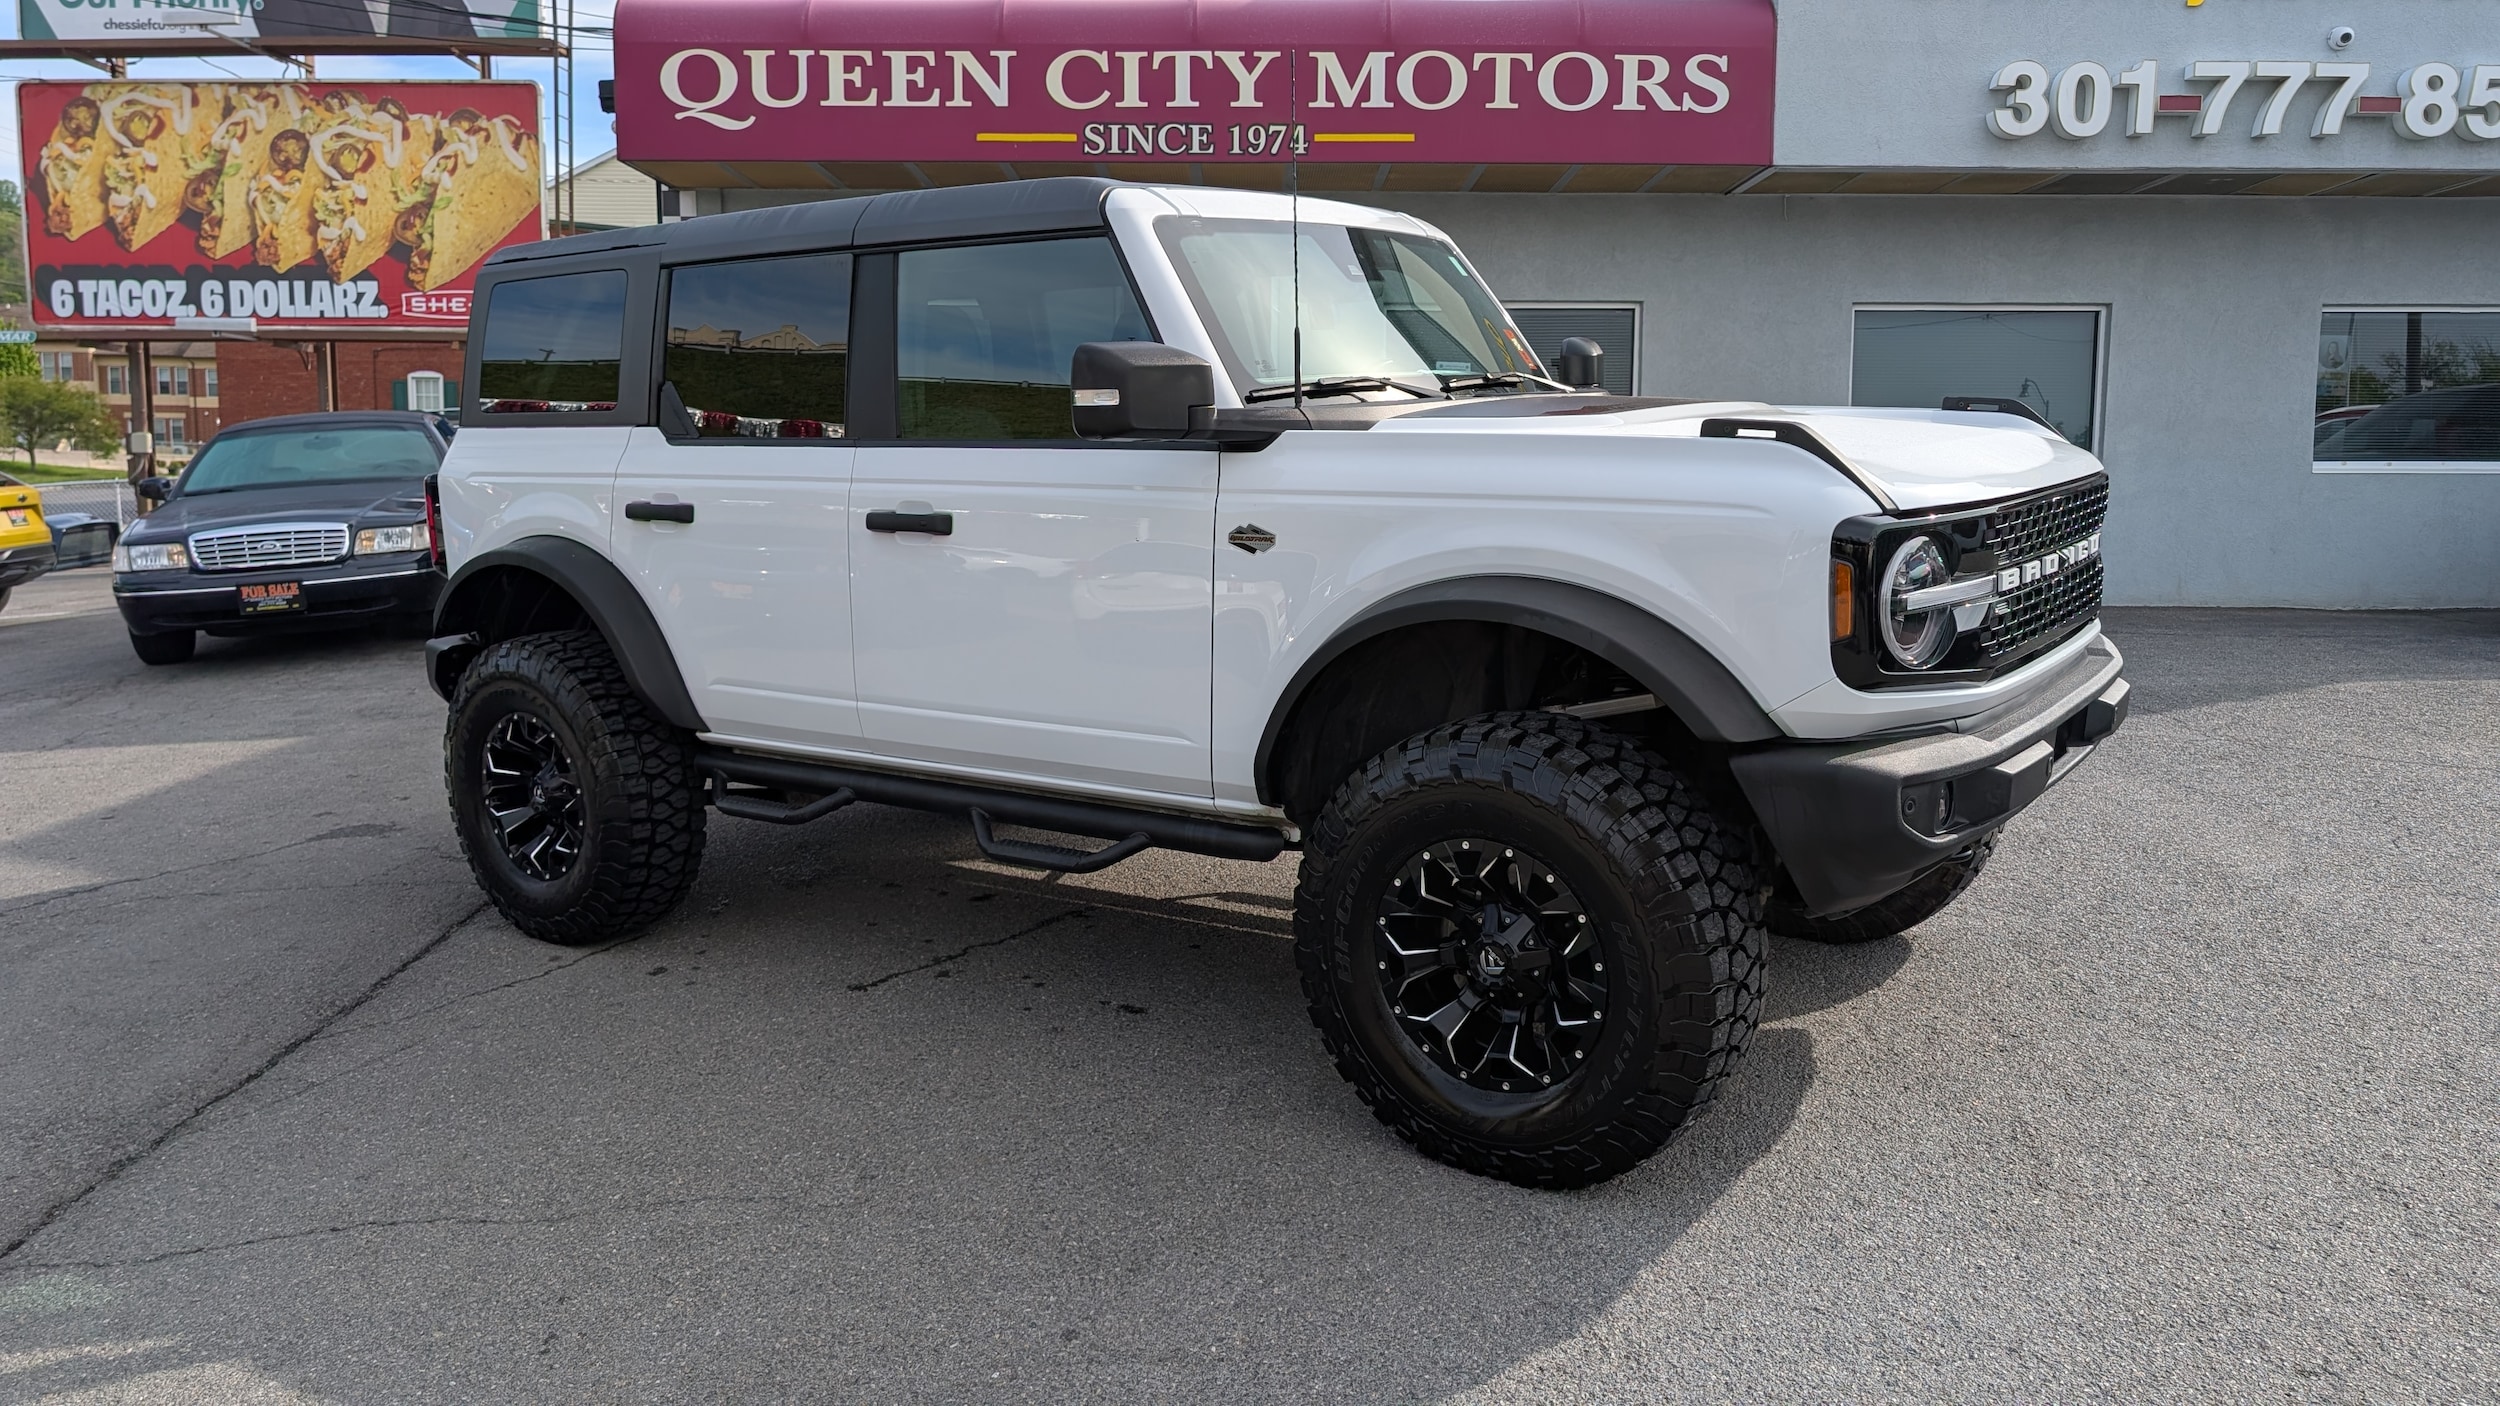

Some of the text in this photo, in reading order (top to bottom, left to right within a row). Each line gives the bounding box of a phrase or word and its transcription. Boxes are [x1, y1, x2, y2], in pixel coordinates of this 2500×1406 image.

[659, 48, 1731, 131] QUEEN CITY MOTORS
[1083, 122, 1309, 155] SINCE 1974
[51, 279, 389, 318] 6 TACOZ. 6 DOLLARZ.
[411, 297, 472, 313] SHE
[1998, 533, 2101, 593] BRONCO
[240, 584, 267, 599] FOR
[268, 582, 300, 597] SALE
